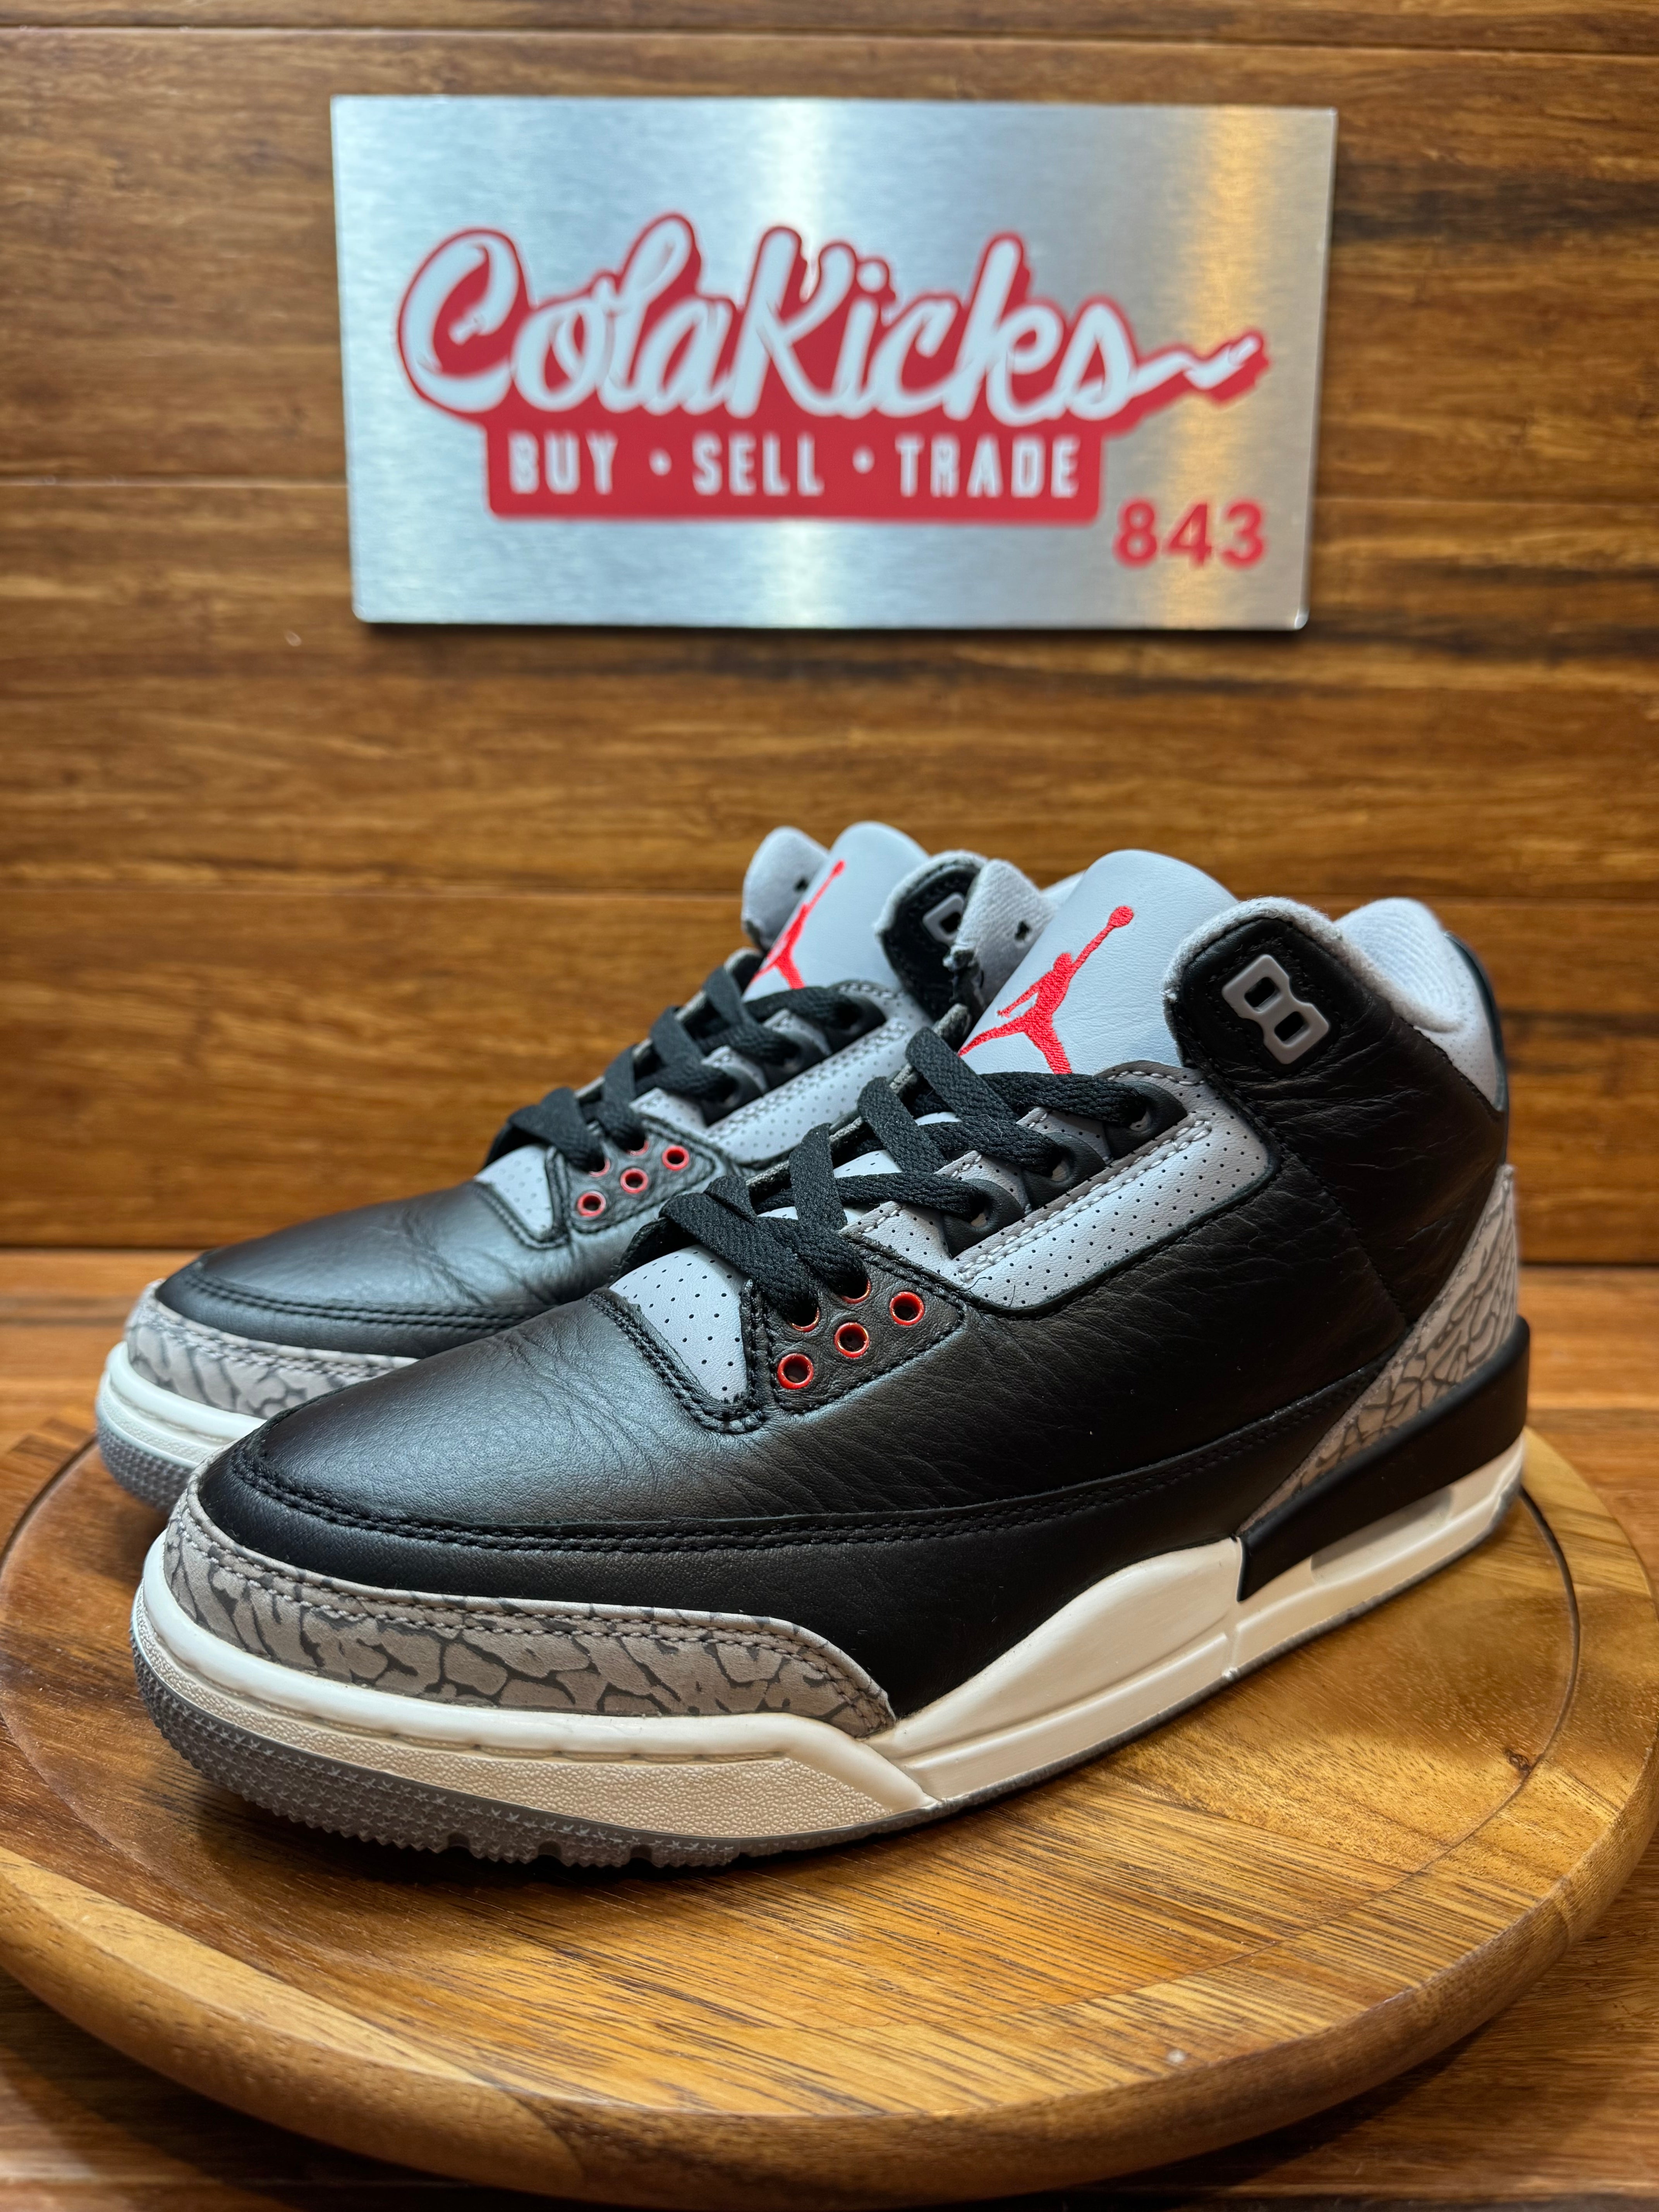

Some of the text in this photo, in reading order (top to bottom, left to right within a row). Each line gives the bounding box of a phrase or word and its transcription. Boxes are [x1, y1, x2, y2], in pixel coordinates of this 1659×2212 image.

[400, 215, 1263, 427] ColaKicks
[507, 430, 1080, 499] BUY SELL TRADE
[1112, 497, 1266, 570] 843
